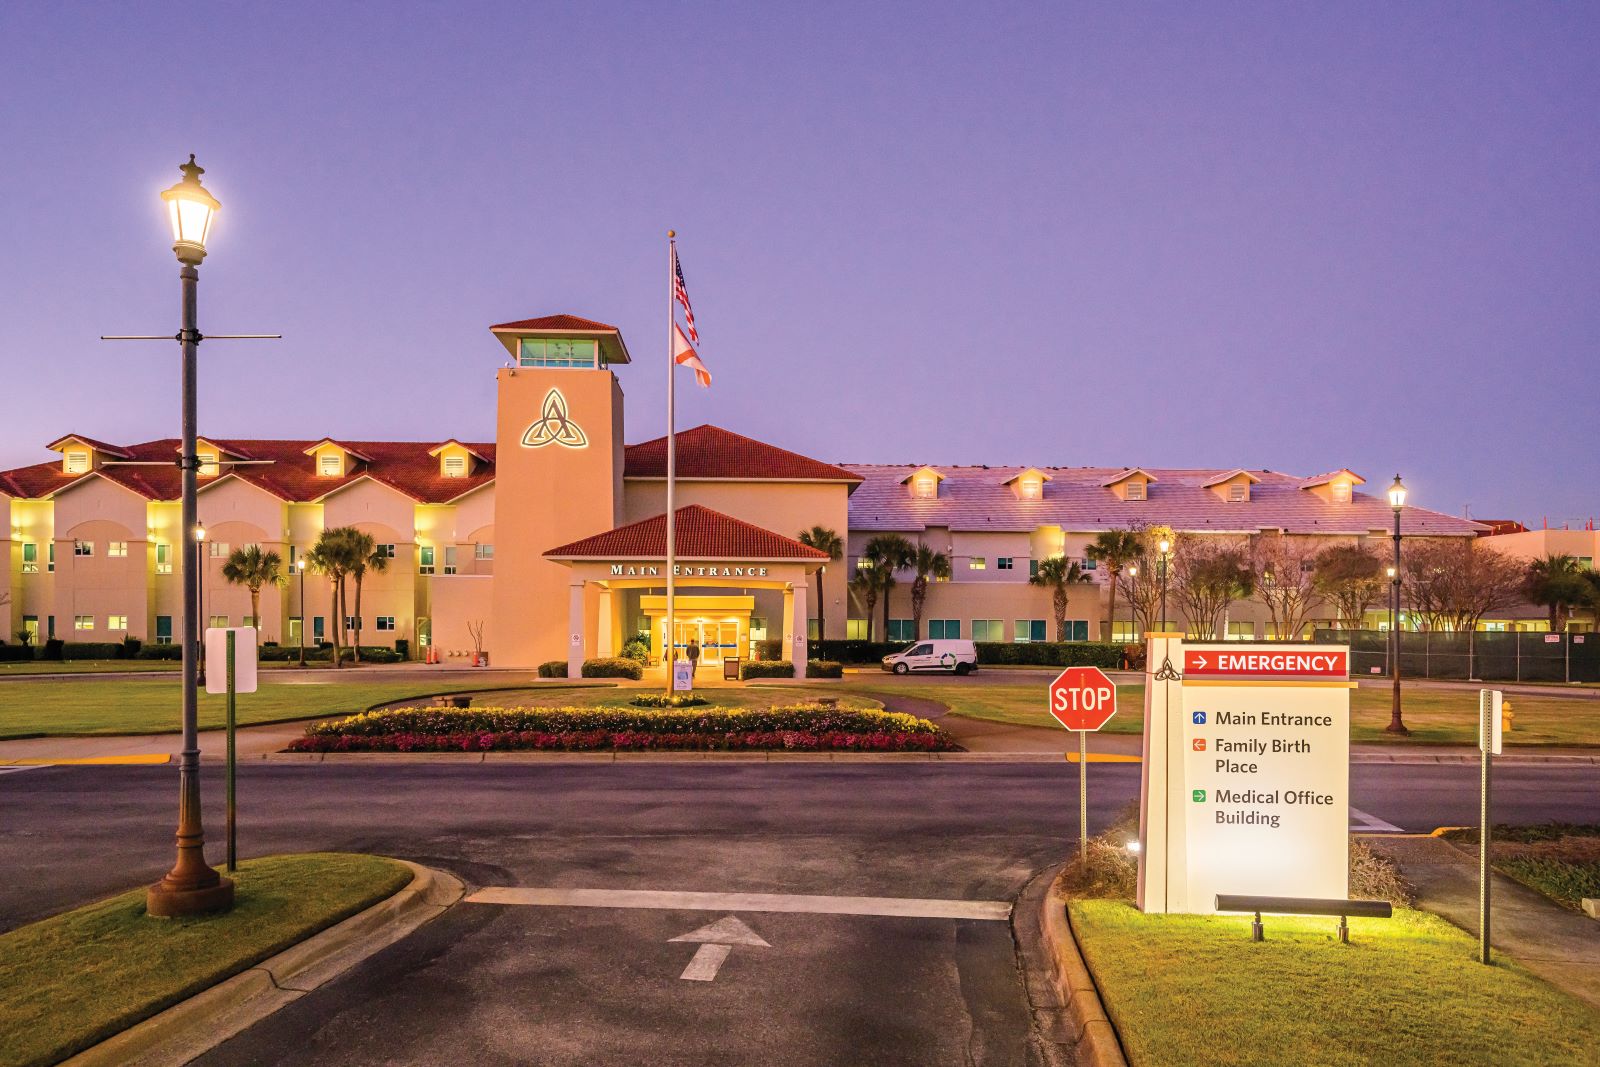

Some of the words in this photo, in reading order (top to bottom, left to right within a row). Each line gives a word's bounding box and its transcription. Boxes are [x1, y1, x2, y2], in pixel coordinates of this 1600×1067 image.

[610, 564, 658, 576] MAIN
[673, 564, 768, 577] ENTRANCE
[1218, 654, 1338, 672] EMERGENCY
[1054, 687, 1111, 711] STOP
[1215, 711, 1256, 726] Main
[1261, 711, 1332, 727] Entrance
[1215, 738, 1267, 755] Family
[1272, 739, 1311, 753] Birth
[1215, 759, 1258, 774] Place
[1215, 789, 1279, 804] Medical
[1284, 790, 1334, 806] Office
[1215, 810, 1280, 828] Building
